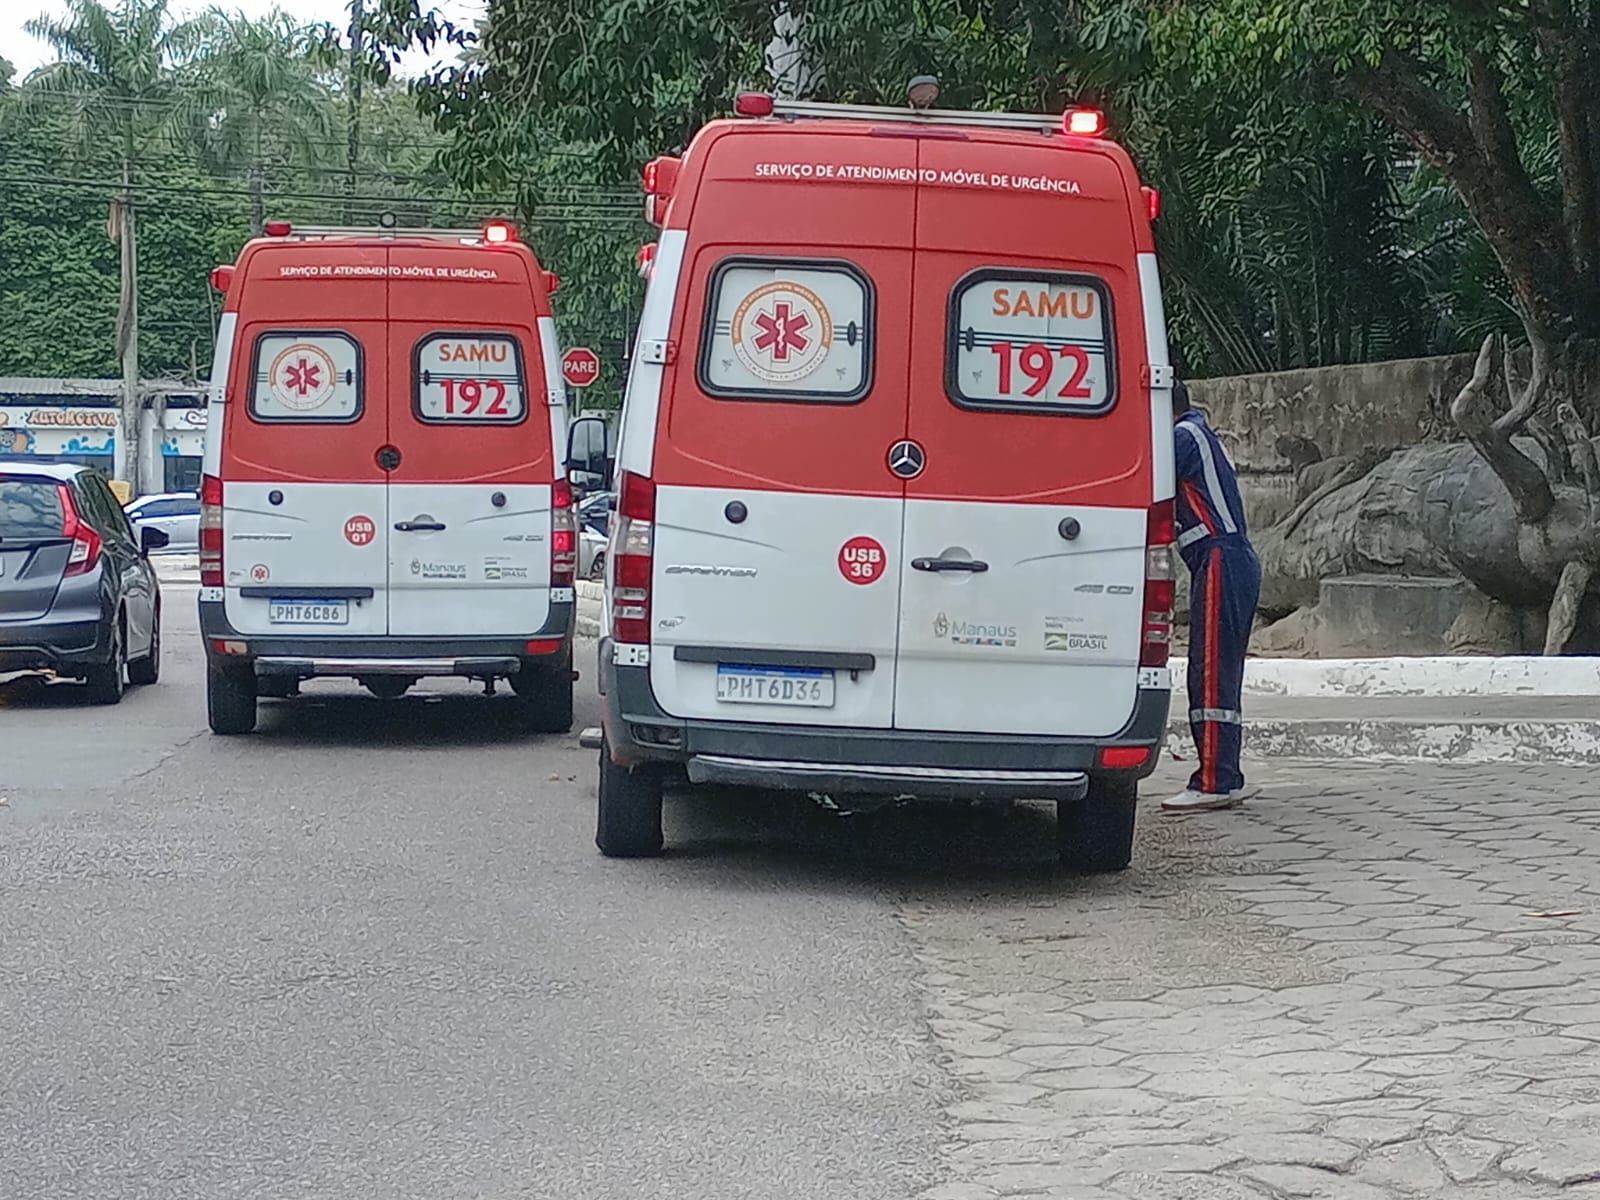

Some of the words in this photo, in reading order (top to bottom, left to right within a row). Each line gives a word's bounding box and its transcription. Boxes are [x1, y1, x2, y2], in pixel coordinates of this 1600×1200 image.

[755, 164, 813, 179] SERVIÇO
[815, 165, 834, 177] DE
[836, 166, 937, 182] ATENDIMENTO
[940, 168, 988, 186] MÓVEL
[991, 174, 1009, 187] DE
[1011, 175, 1081, 194] URGÊNCIA
[279, 266, 318, 276] SERVIÇO
[320, 267, 332, 275] DE
[333, 266, 401, 276] ATENDIMENTO
[402, 267, 435, 277] MÓVEL
[436, 268, 449, 277] DE
[450, 267, 497, 279] URGÊNCIA
[992, 287, 1095, 320] SAMU
[438, 343, 507, 362] SAMU
[563, 360, 597, 374] PARE
[991, 341, 1092, 399] 192
[440, 378, 508, 415] 192
[352, 532, 368, 544] 01
[843, 547, 881, 564] USB
[422, 562, 467, 573] Manaus
[850, 562, 874, 578] 36
[952, 621, 1017, 638] Manaus
[1068, 638, 1107, 650] BRASIL
[727, 676, 821, 701] PHT6D36
